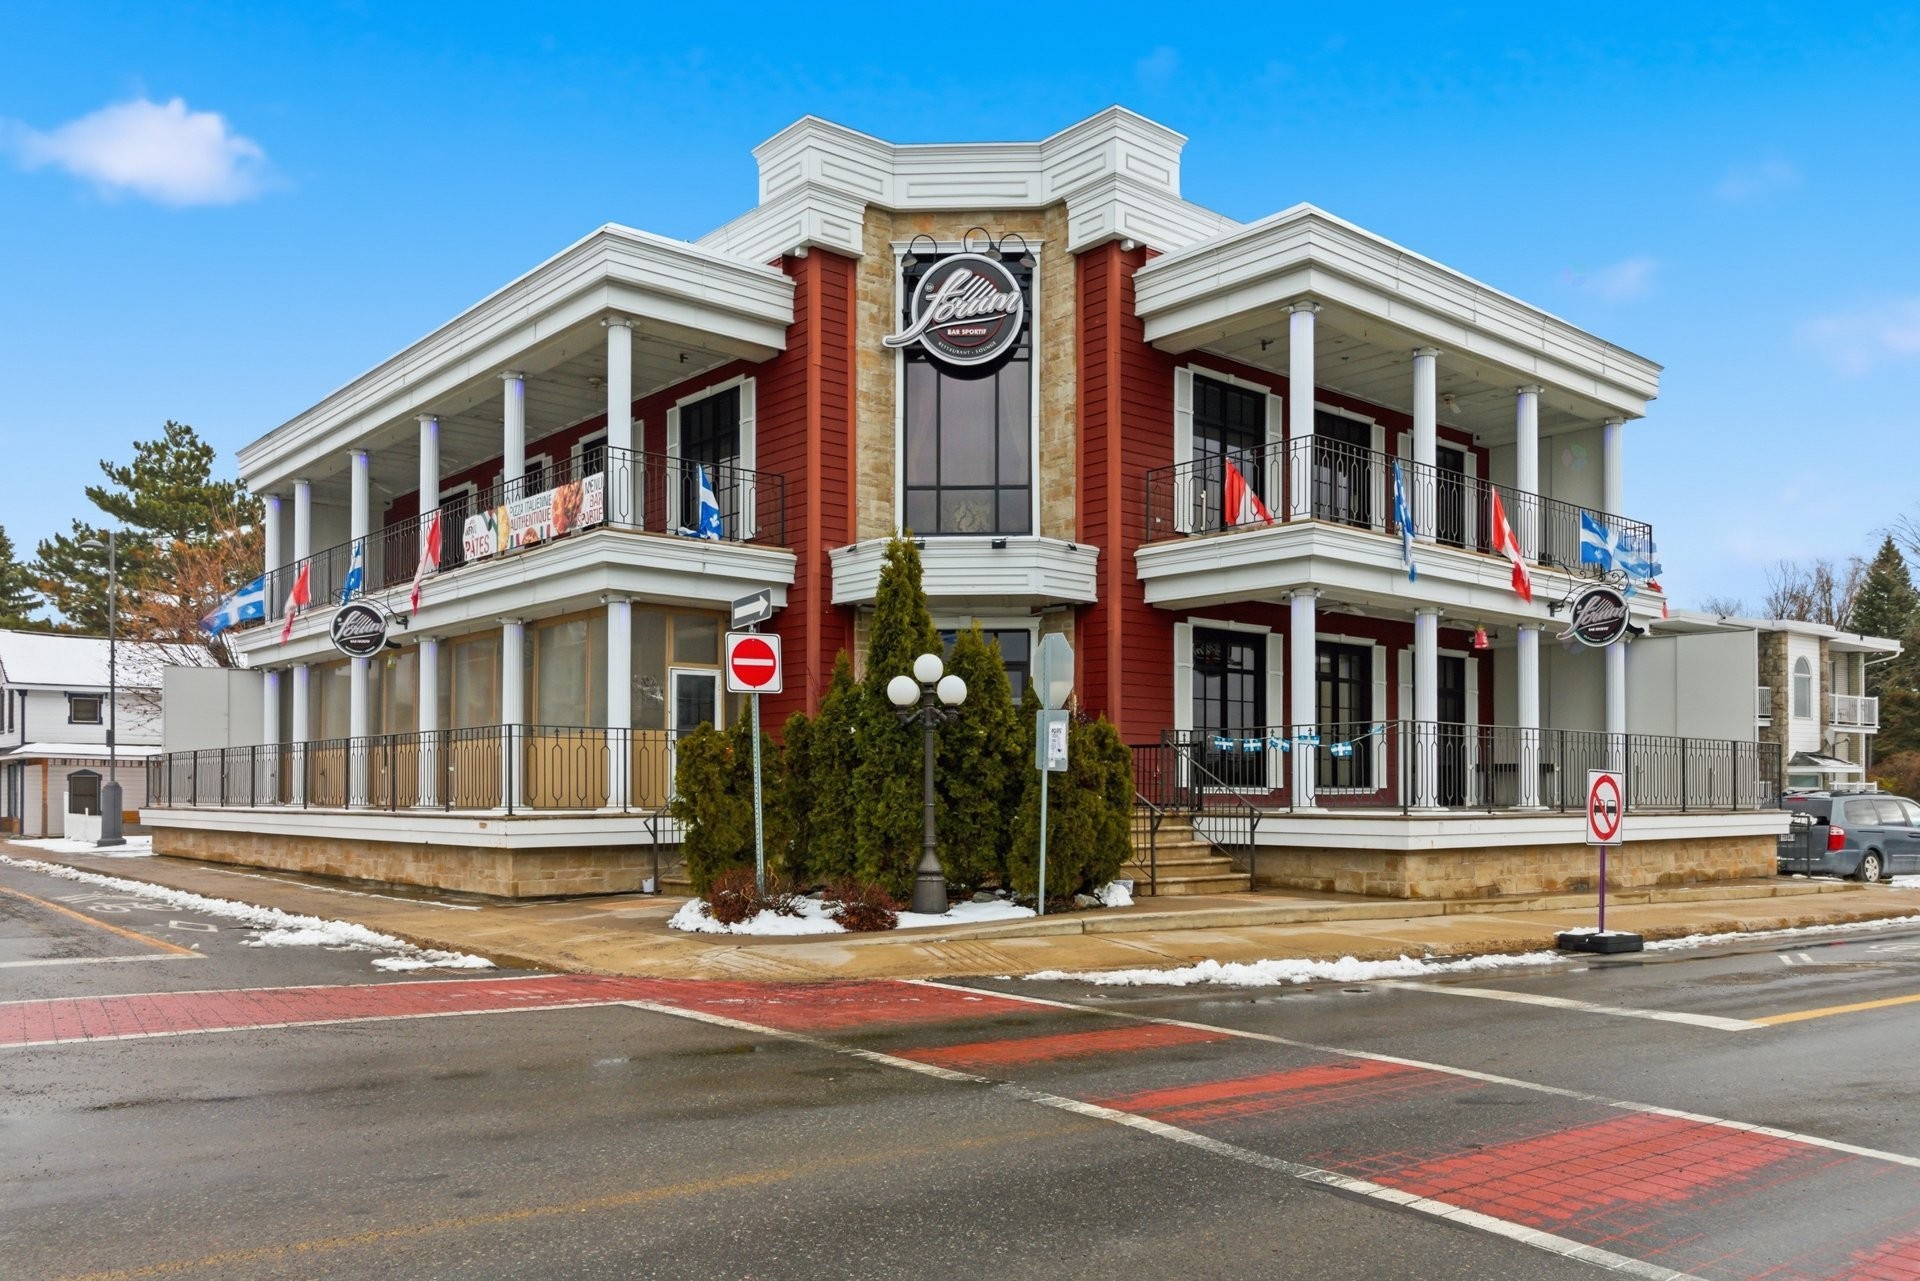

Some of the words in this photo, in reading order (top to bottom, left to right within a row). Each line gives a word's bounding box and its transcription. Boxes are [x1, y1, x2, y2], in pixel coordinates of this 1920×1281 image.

[947, 328, 961, 336] BAR
[961, 328, 988, 336] SPORTIF
[584, 474, 603, 496] MENU
[589, 490, 603, 508] BAR
[510, 503, 523, 518] PIZZA
[510, 506, 552, 532] AUTHENTIQUE
[576, 507, 603, 528] SPORTIF
